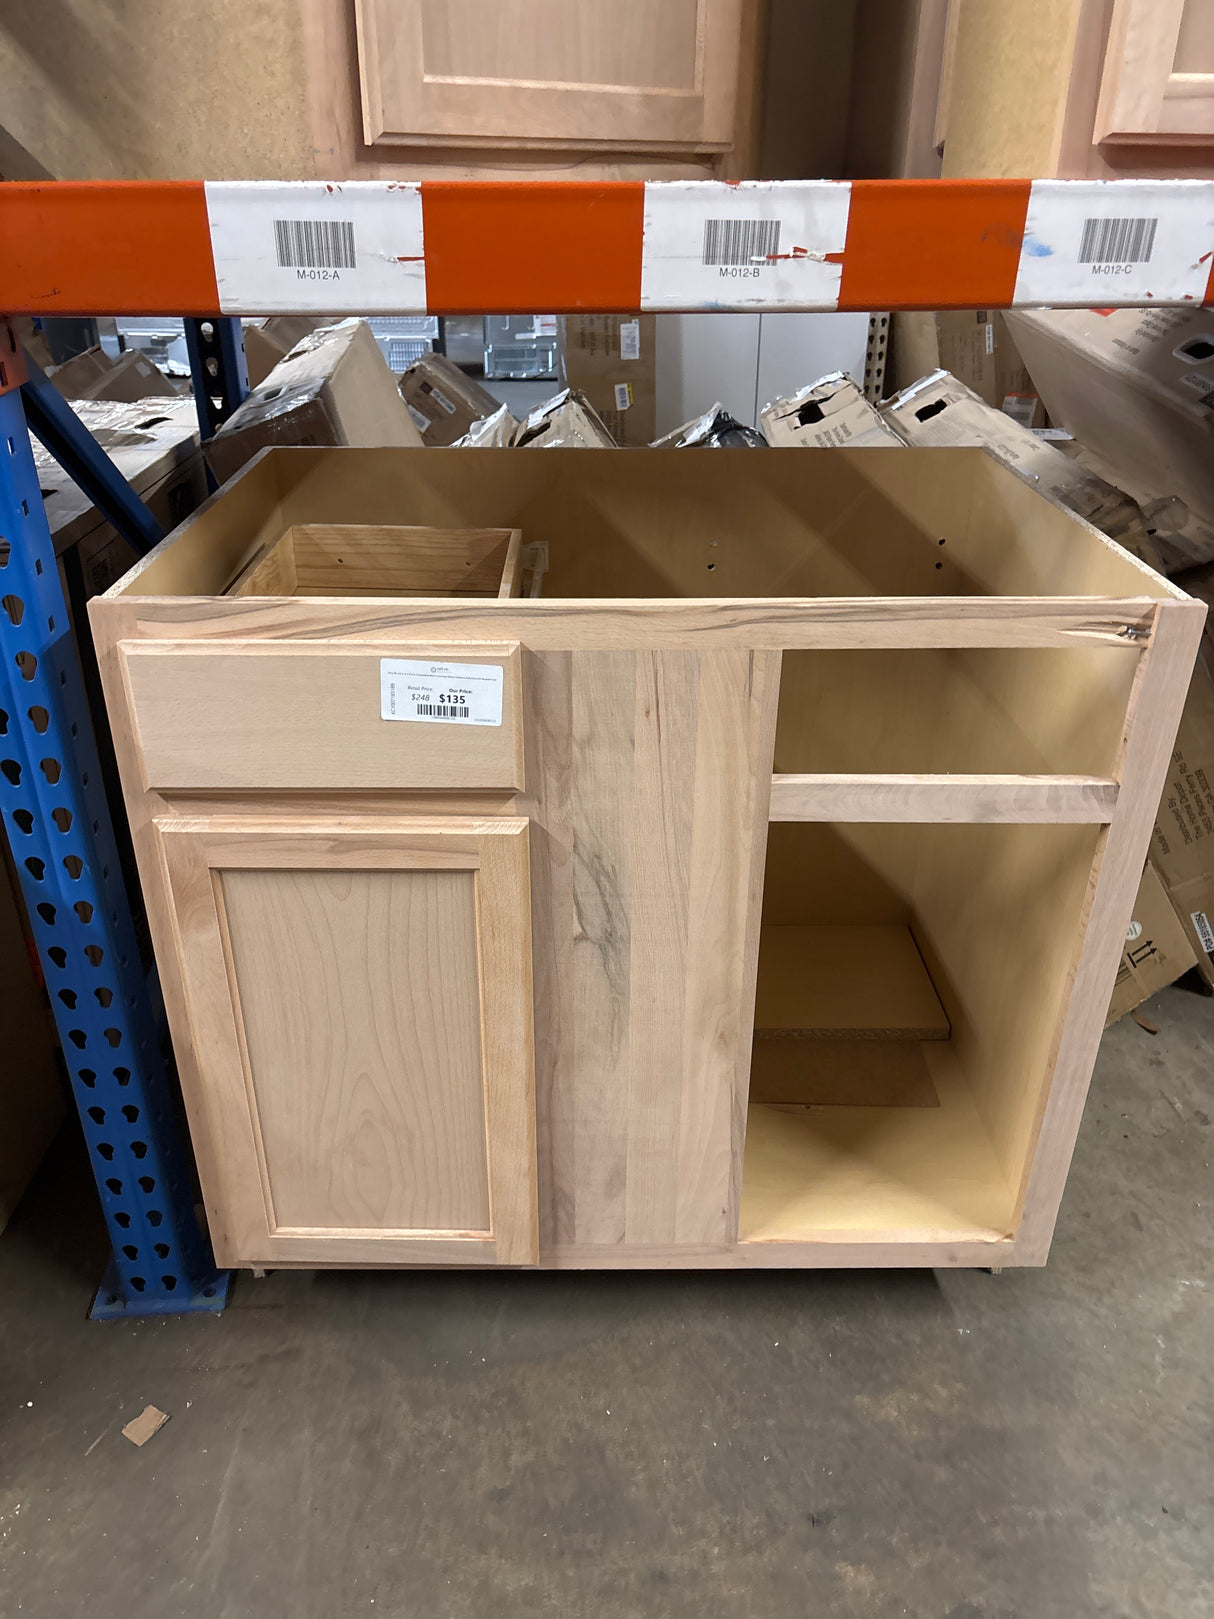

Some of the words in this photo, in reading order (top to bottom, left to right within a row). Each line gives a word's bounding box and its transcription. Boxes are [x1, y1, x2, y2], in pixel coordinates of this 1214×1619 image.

[297, 269, 340, 280] M-012-A
[719, 267, 760, 278] M-012-B
[1091, 264, 1133, 275] M-012-C
[411, 693, 430, 702] $248
[439, 693, 466, 704] $135
[1185, 774, 1197, 795] Ferry
